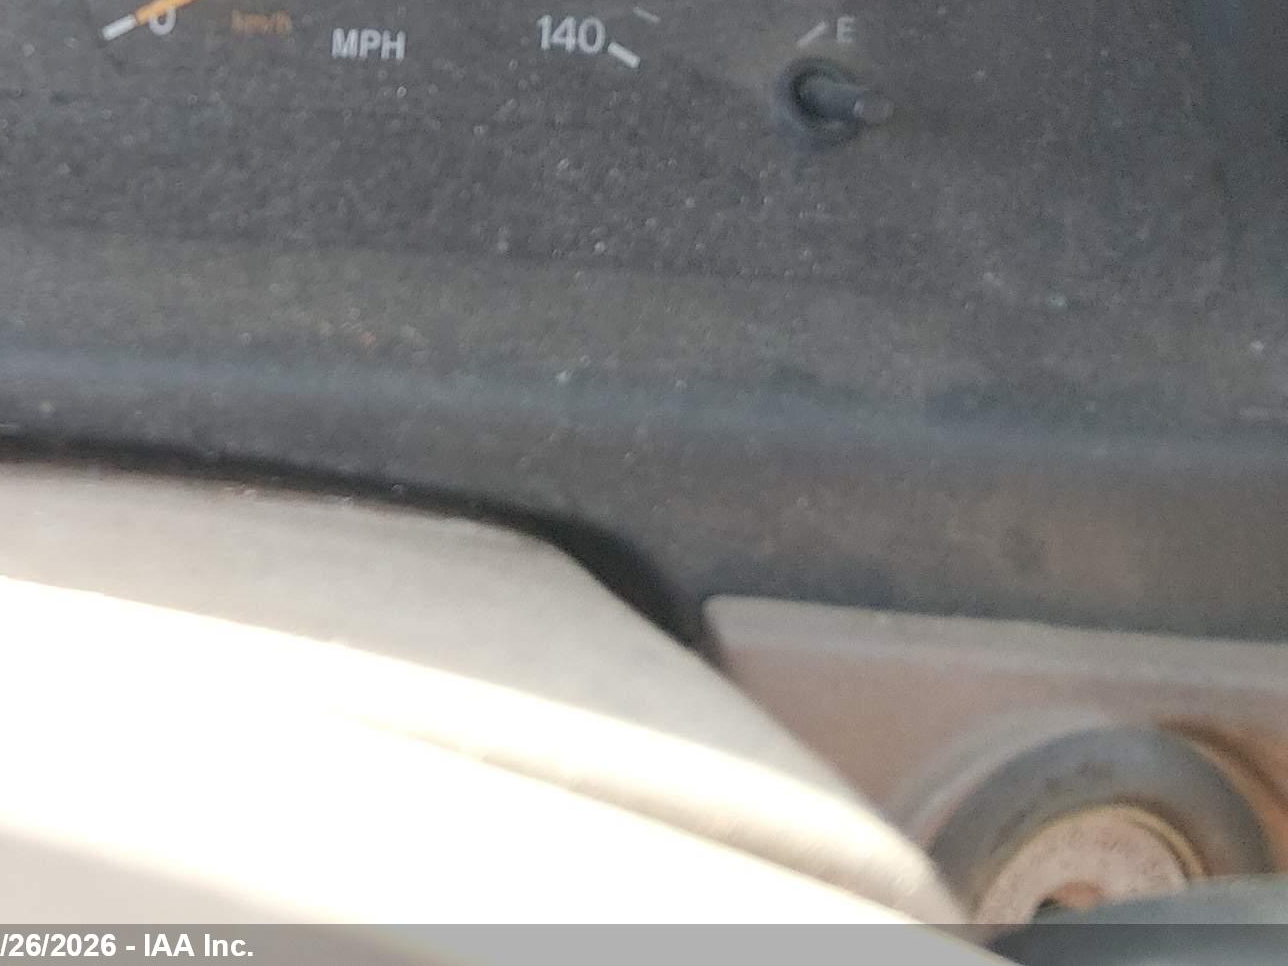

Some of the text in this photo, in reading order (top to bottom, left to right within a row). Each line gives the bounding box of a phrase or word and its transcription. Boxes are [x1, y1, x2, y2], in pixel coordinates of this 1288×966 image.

[331, 28, 406, 60] MPH
[537, 16, 606, 53] 140
[836, 17, 857, 43] E
